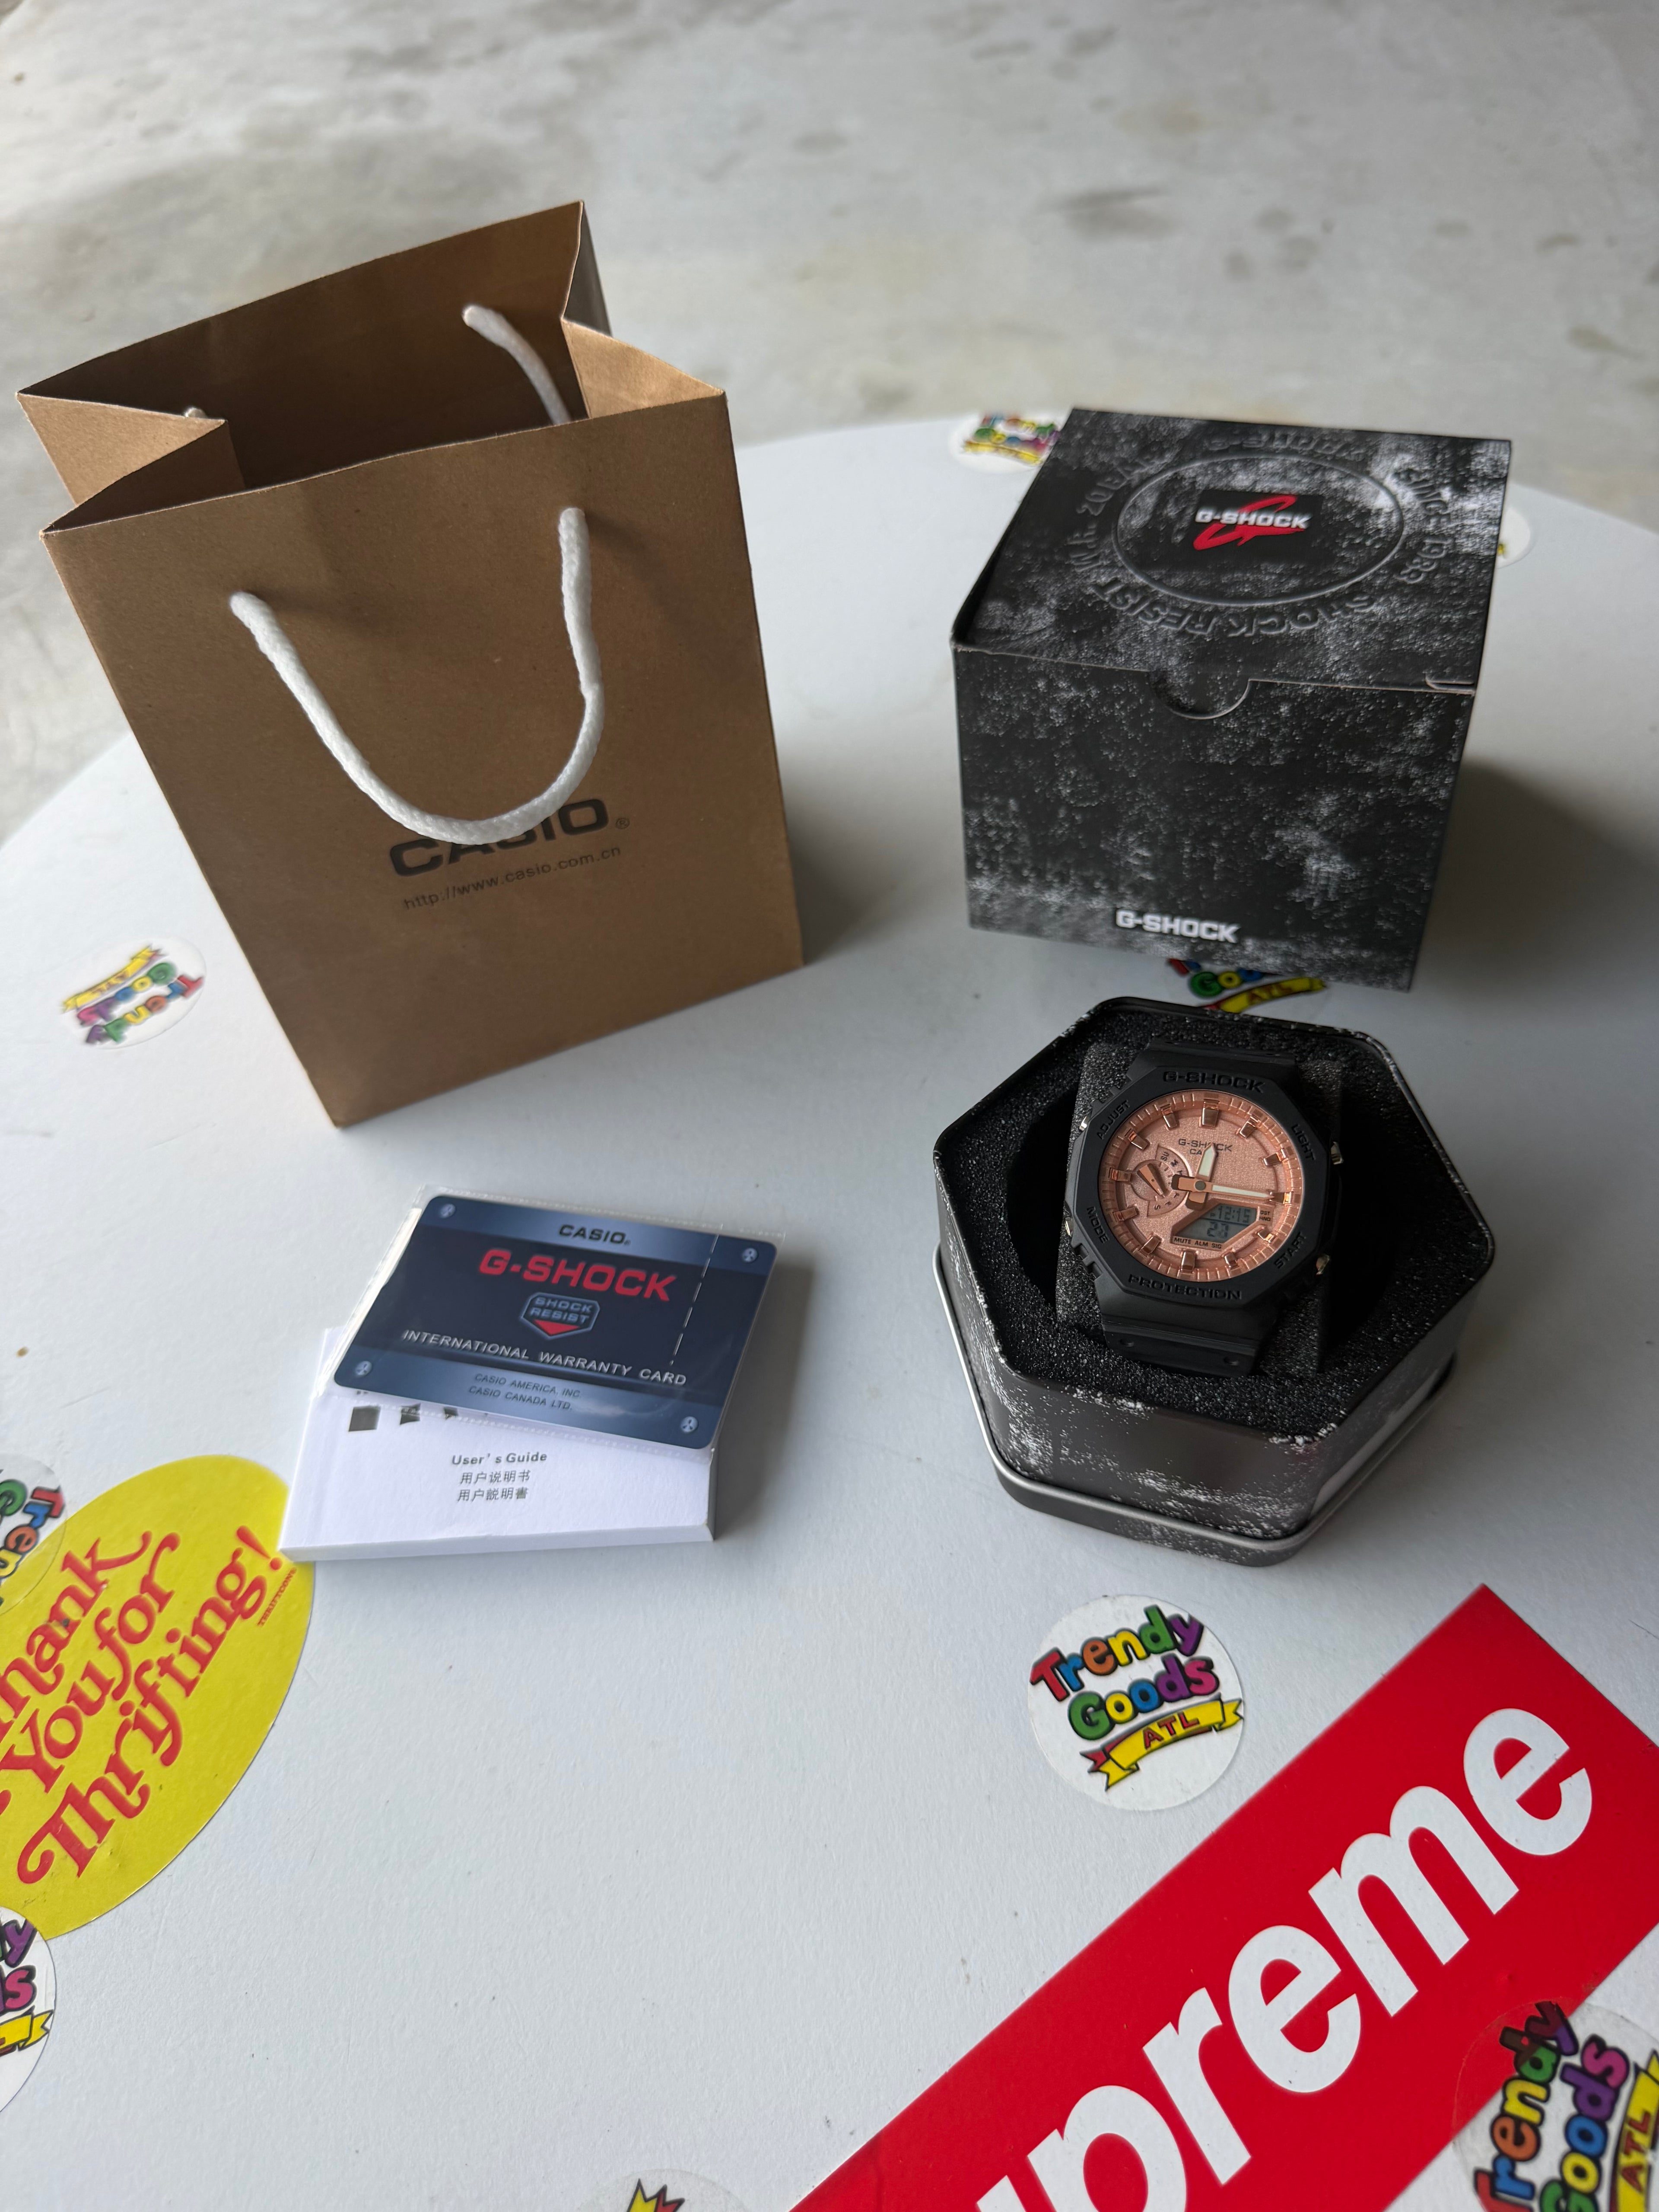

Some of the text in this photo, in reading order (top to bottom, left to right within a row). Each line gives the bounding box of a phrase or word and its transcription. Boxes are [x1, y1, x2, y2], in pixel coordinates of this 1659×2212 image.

[1195, 506, 1311, 531] G-SHOCK
[1393, 536, 1452, 584] 1983
[1089, 578, 1376, 638] SHOCK RESIST
[404, 845, 621, 909] http://www.casio.com.cn
[1116, 909, 1241, 944] G-SHOCK
[1163, 1071, 1265, 1093] G-SHOCK
[1096, 1099, 1130, 1140] ADJUST
[1291, 1124, 1316, 1161] LIGHT
[559, 1224, 627, 1245] CASIO
[1087, 1206, 1110, 1244] MODE
[1274, 1230, 1306, 1269] START
[479, 1249, 677, 1301] G-SHOCK
[1128, 1274, 1242, 1300] PROTECTION
[530, 1307, 589, 1324] RESIST
[535, 1297, 593, 1313] SHOCK
[402, 1328, 687, 1386] INTERNATIONAL WARRANTY CARD
[469, 1385, 573, 1411] CASIO CANADA LTD.
[475, 1373, 506, 1385] CASIO
[510, 1379, 559, 1395] AMERICA,
[460, 1469, 531, 1484] 用户说明书
[506, 1452, 547, 1463] Guide
[0, 1485, 64, 1579] Tren
[0, 1531, 153, 1744] hank
[1030, 1604, 1205, 1702] Trendy
[0, 1532, 181, 1794] You for
[17, 1525, 283, 1885] Thrifting!
[1067, 1653, 1220, 1741] Goods
[1142, 1710, 1200, 1750] ATL
[1620, 2108, 1652, 2194] ATL
